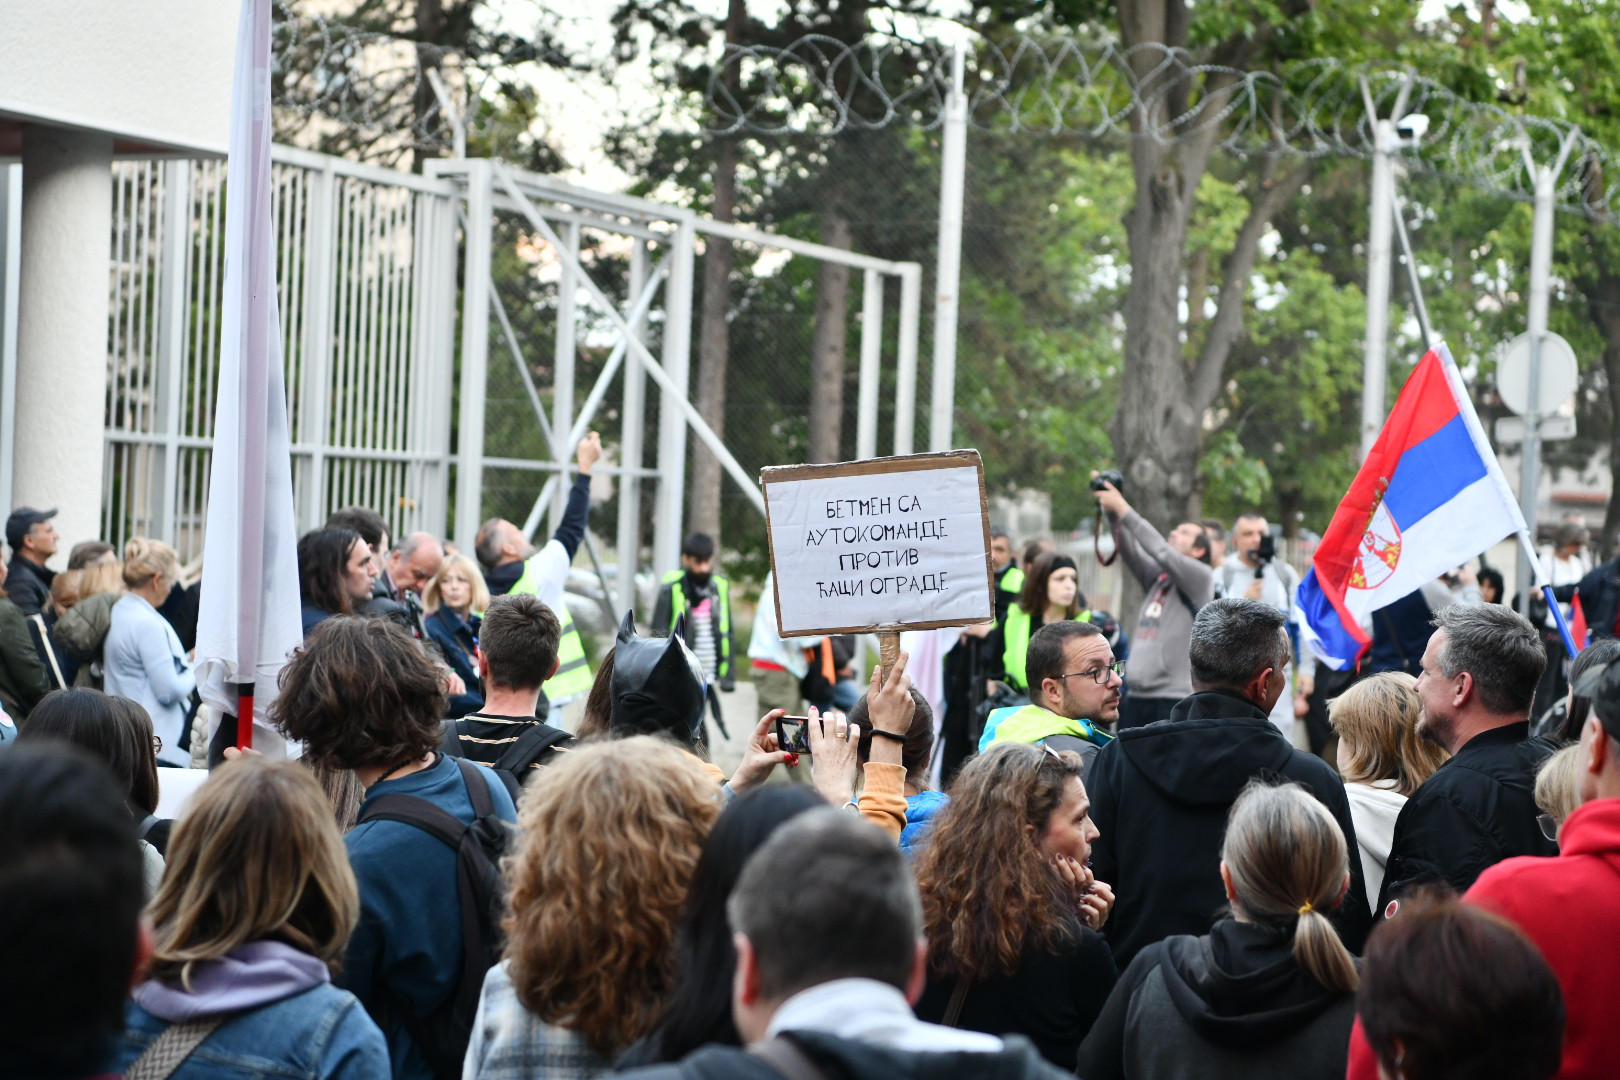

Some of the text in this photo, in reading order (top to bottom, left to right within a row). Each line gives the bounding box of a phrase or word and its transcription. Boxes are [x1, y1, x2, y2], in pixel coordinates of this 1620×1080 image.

[826, 495, 922, 518] БЕТМЕН СА
[806, 518, 949, 546] АУТОКОМАНДЕ
[839, 548, 919, 571] ПРОТИВ
[816, 572, 949, 598] ЋАЦИ ОГРАДЕ
